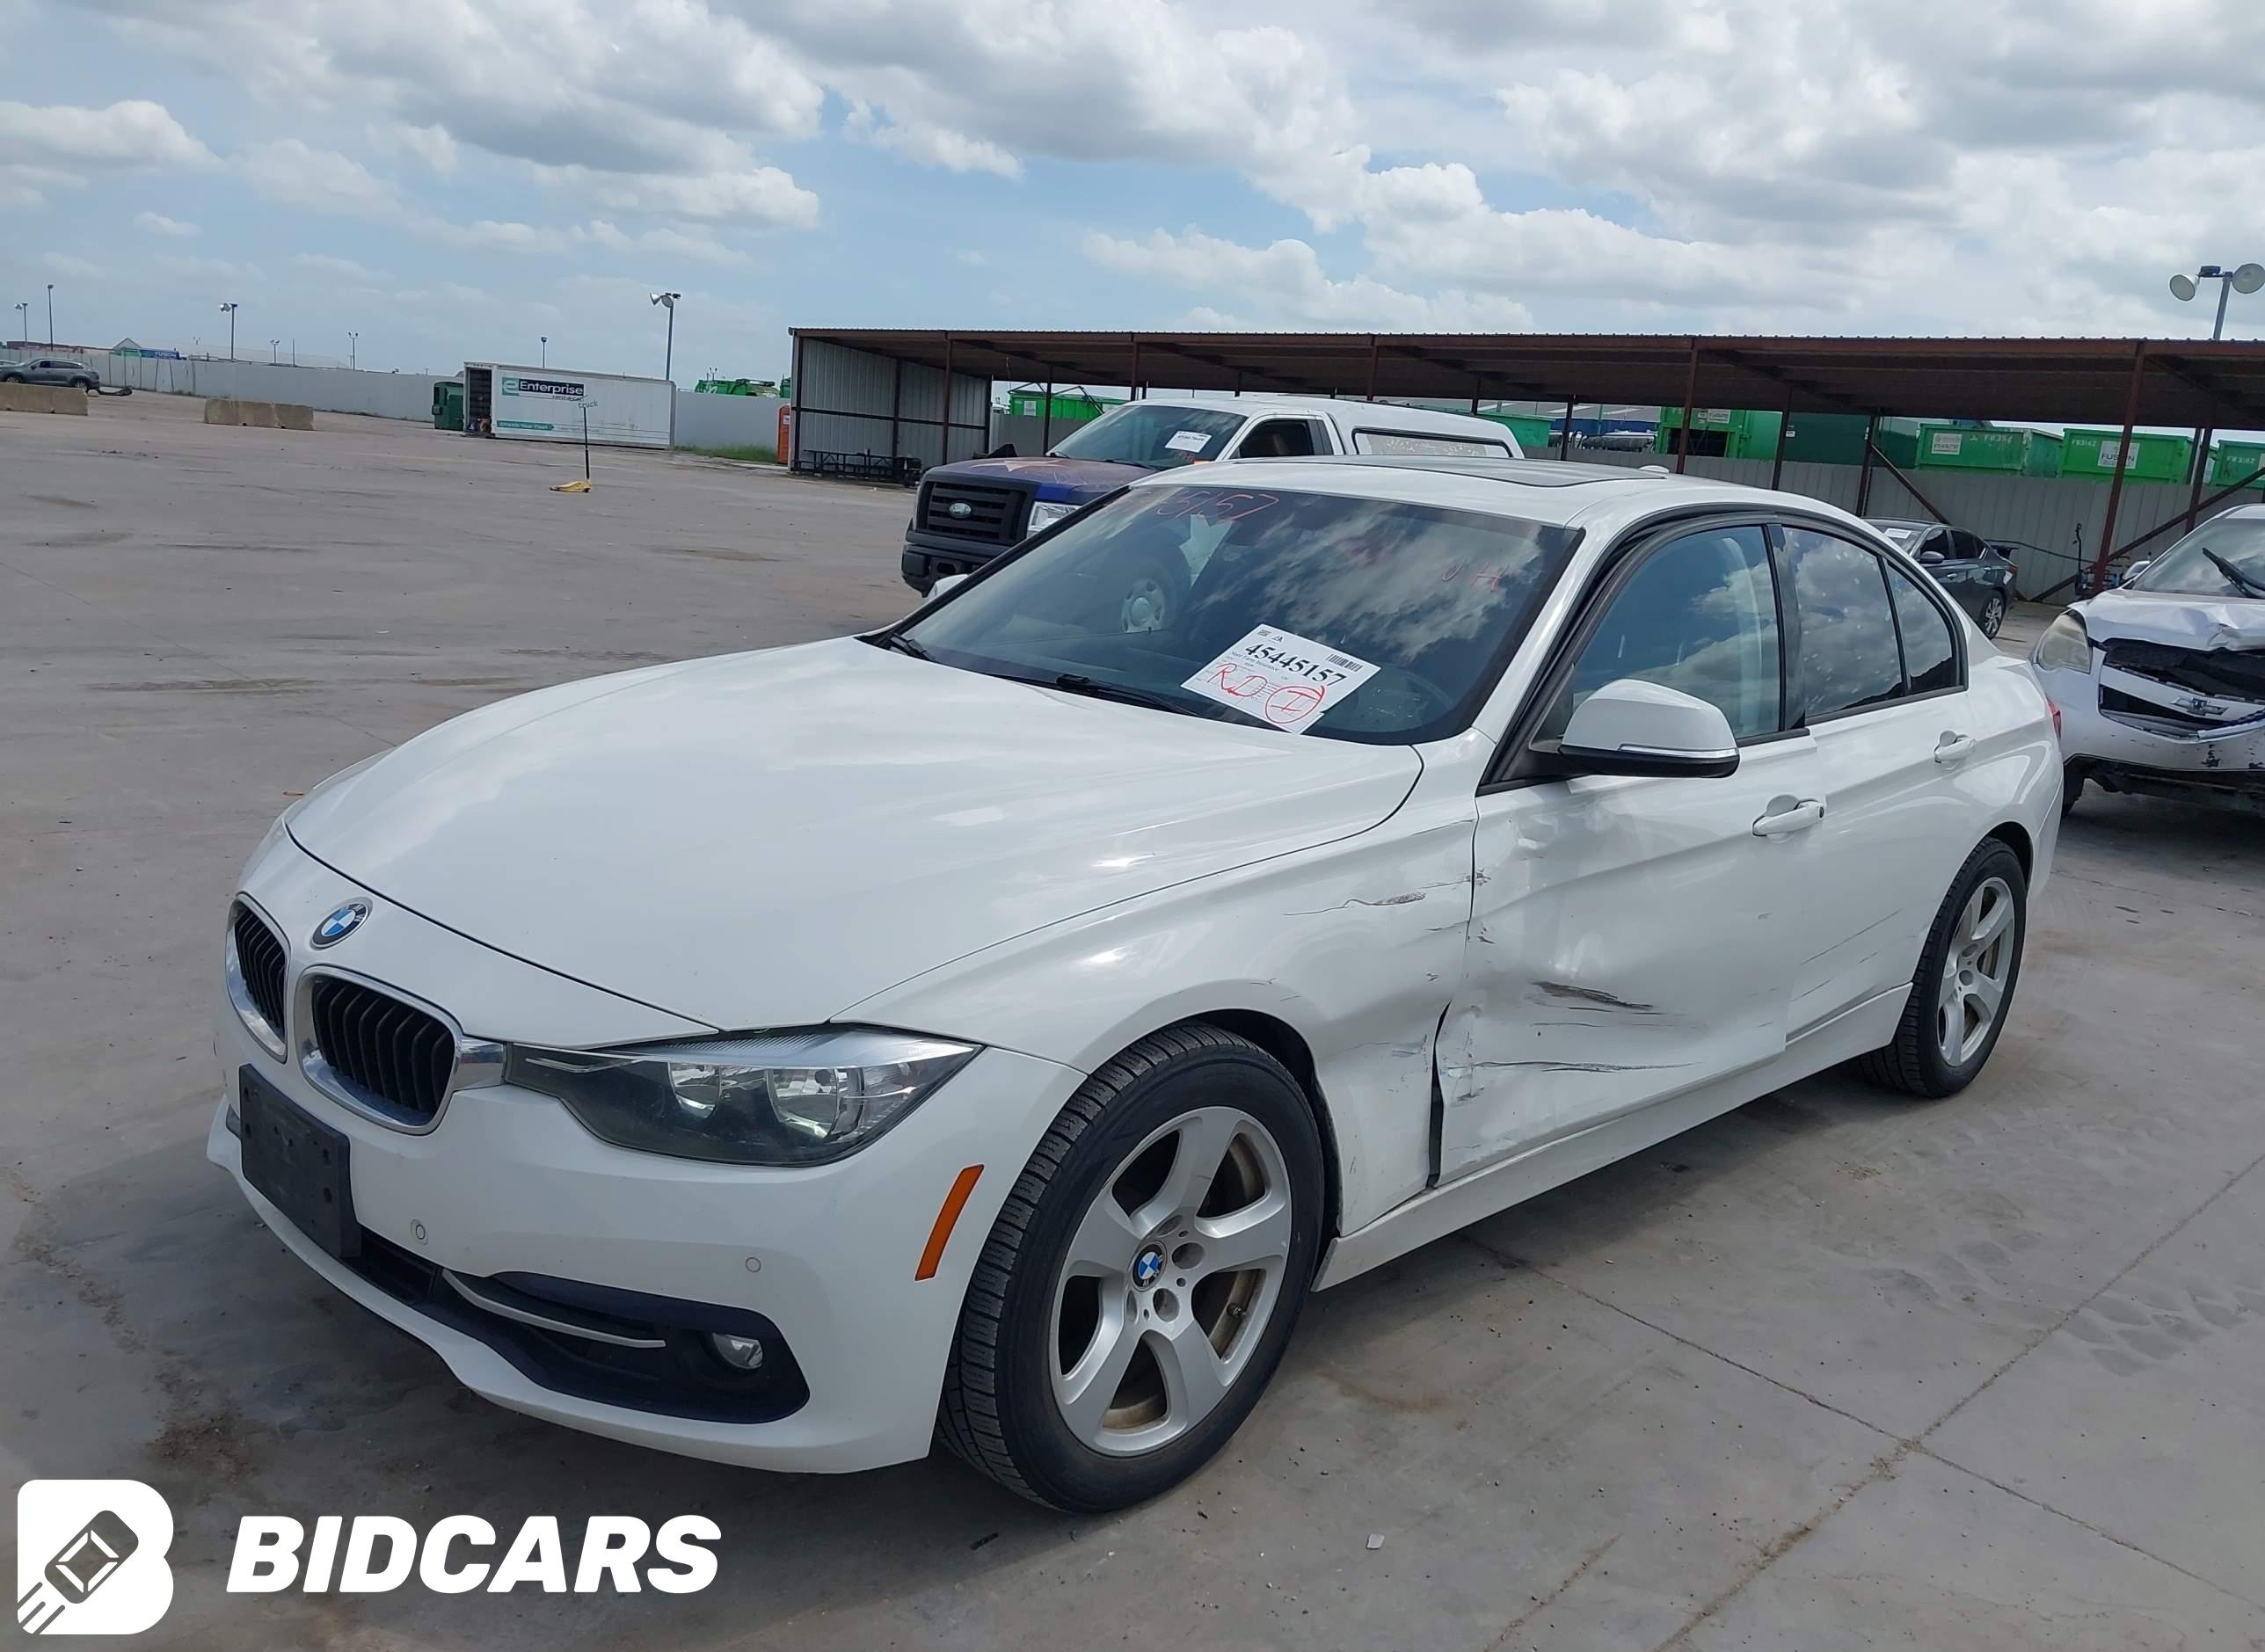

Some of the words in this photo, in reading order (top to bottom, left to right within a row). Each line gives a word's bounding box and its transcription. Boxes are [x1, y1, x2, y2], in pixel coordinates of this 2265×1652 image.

[520, 381, 584, 397] Enterprise
[2101, 453, 2136, 462] FUSN
[1245, 643, 1347, 686] 45445157
